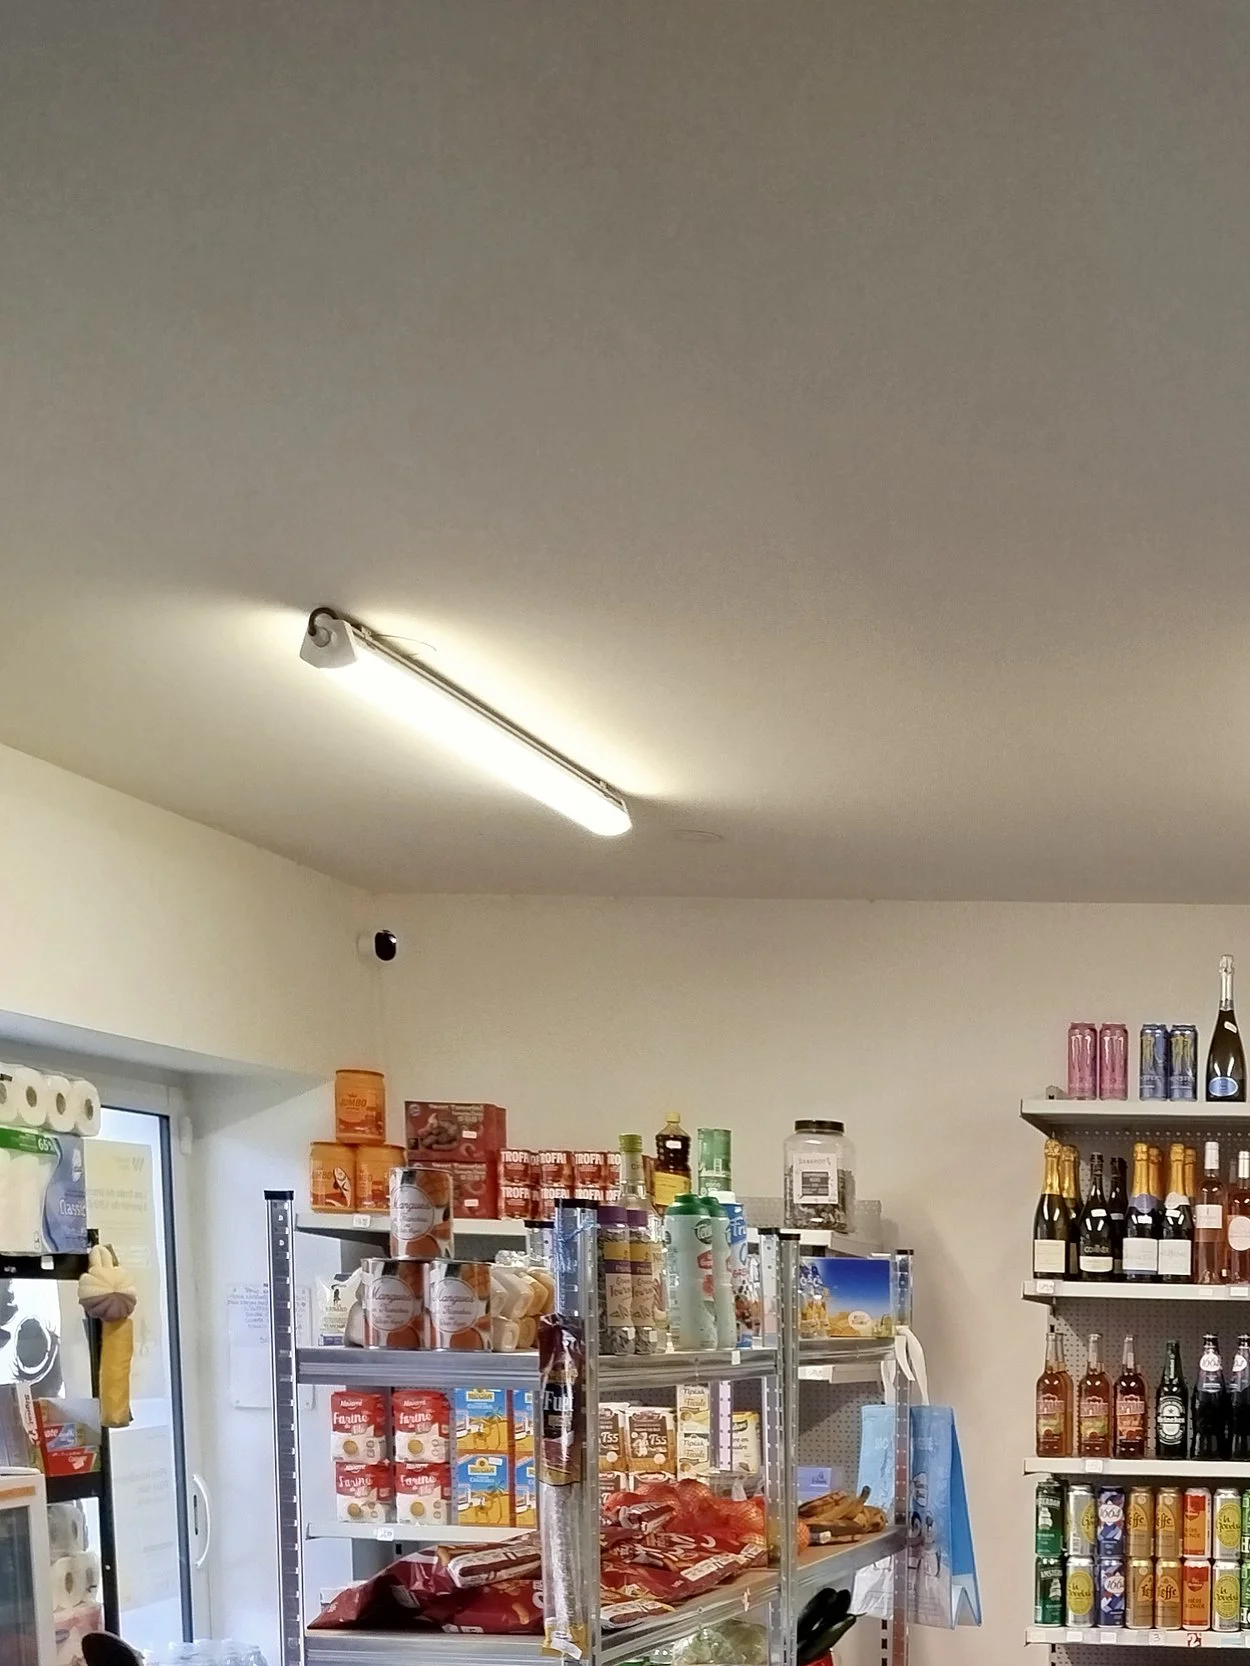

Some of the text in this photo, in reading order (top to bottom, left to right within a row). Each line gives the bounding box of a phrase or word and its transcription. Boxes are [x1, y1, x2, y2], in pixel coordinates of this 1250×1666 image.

[333, 1412, 370, 1425] Farine
[400, 1411, 434, 1425] Farine
[338, 1475, 374, 1488] Farine
[400, 1474, 437, 1487] Farine
